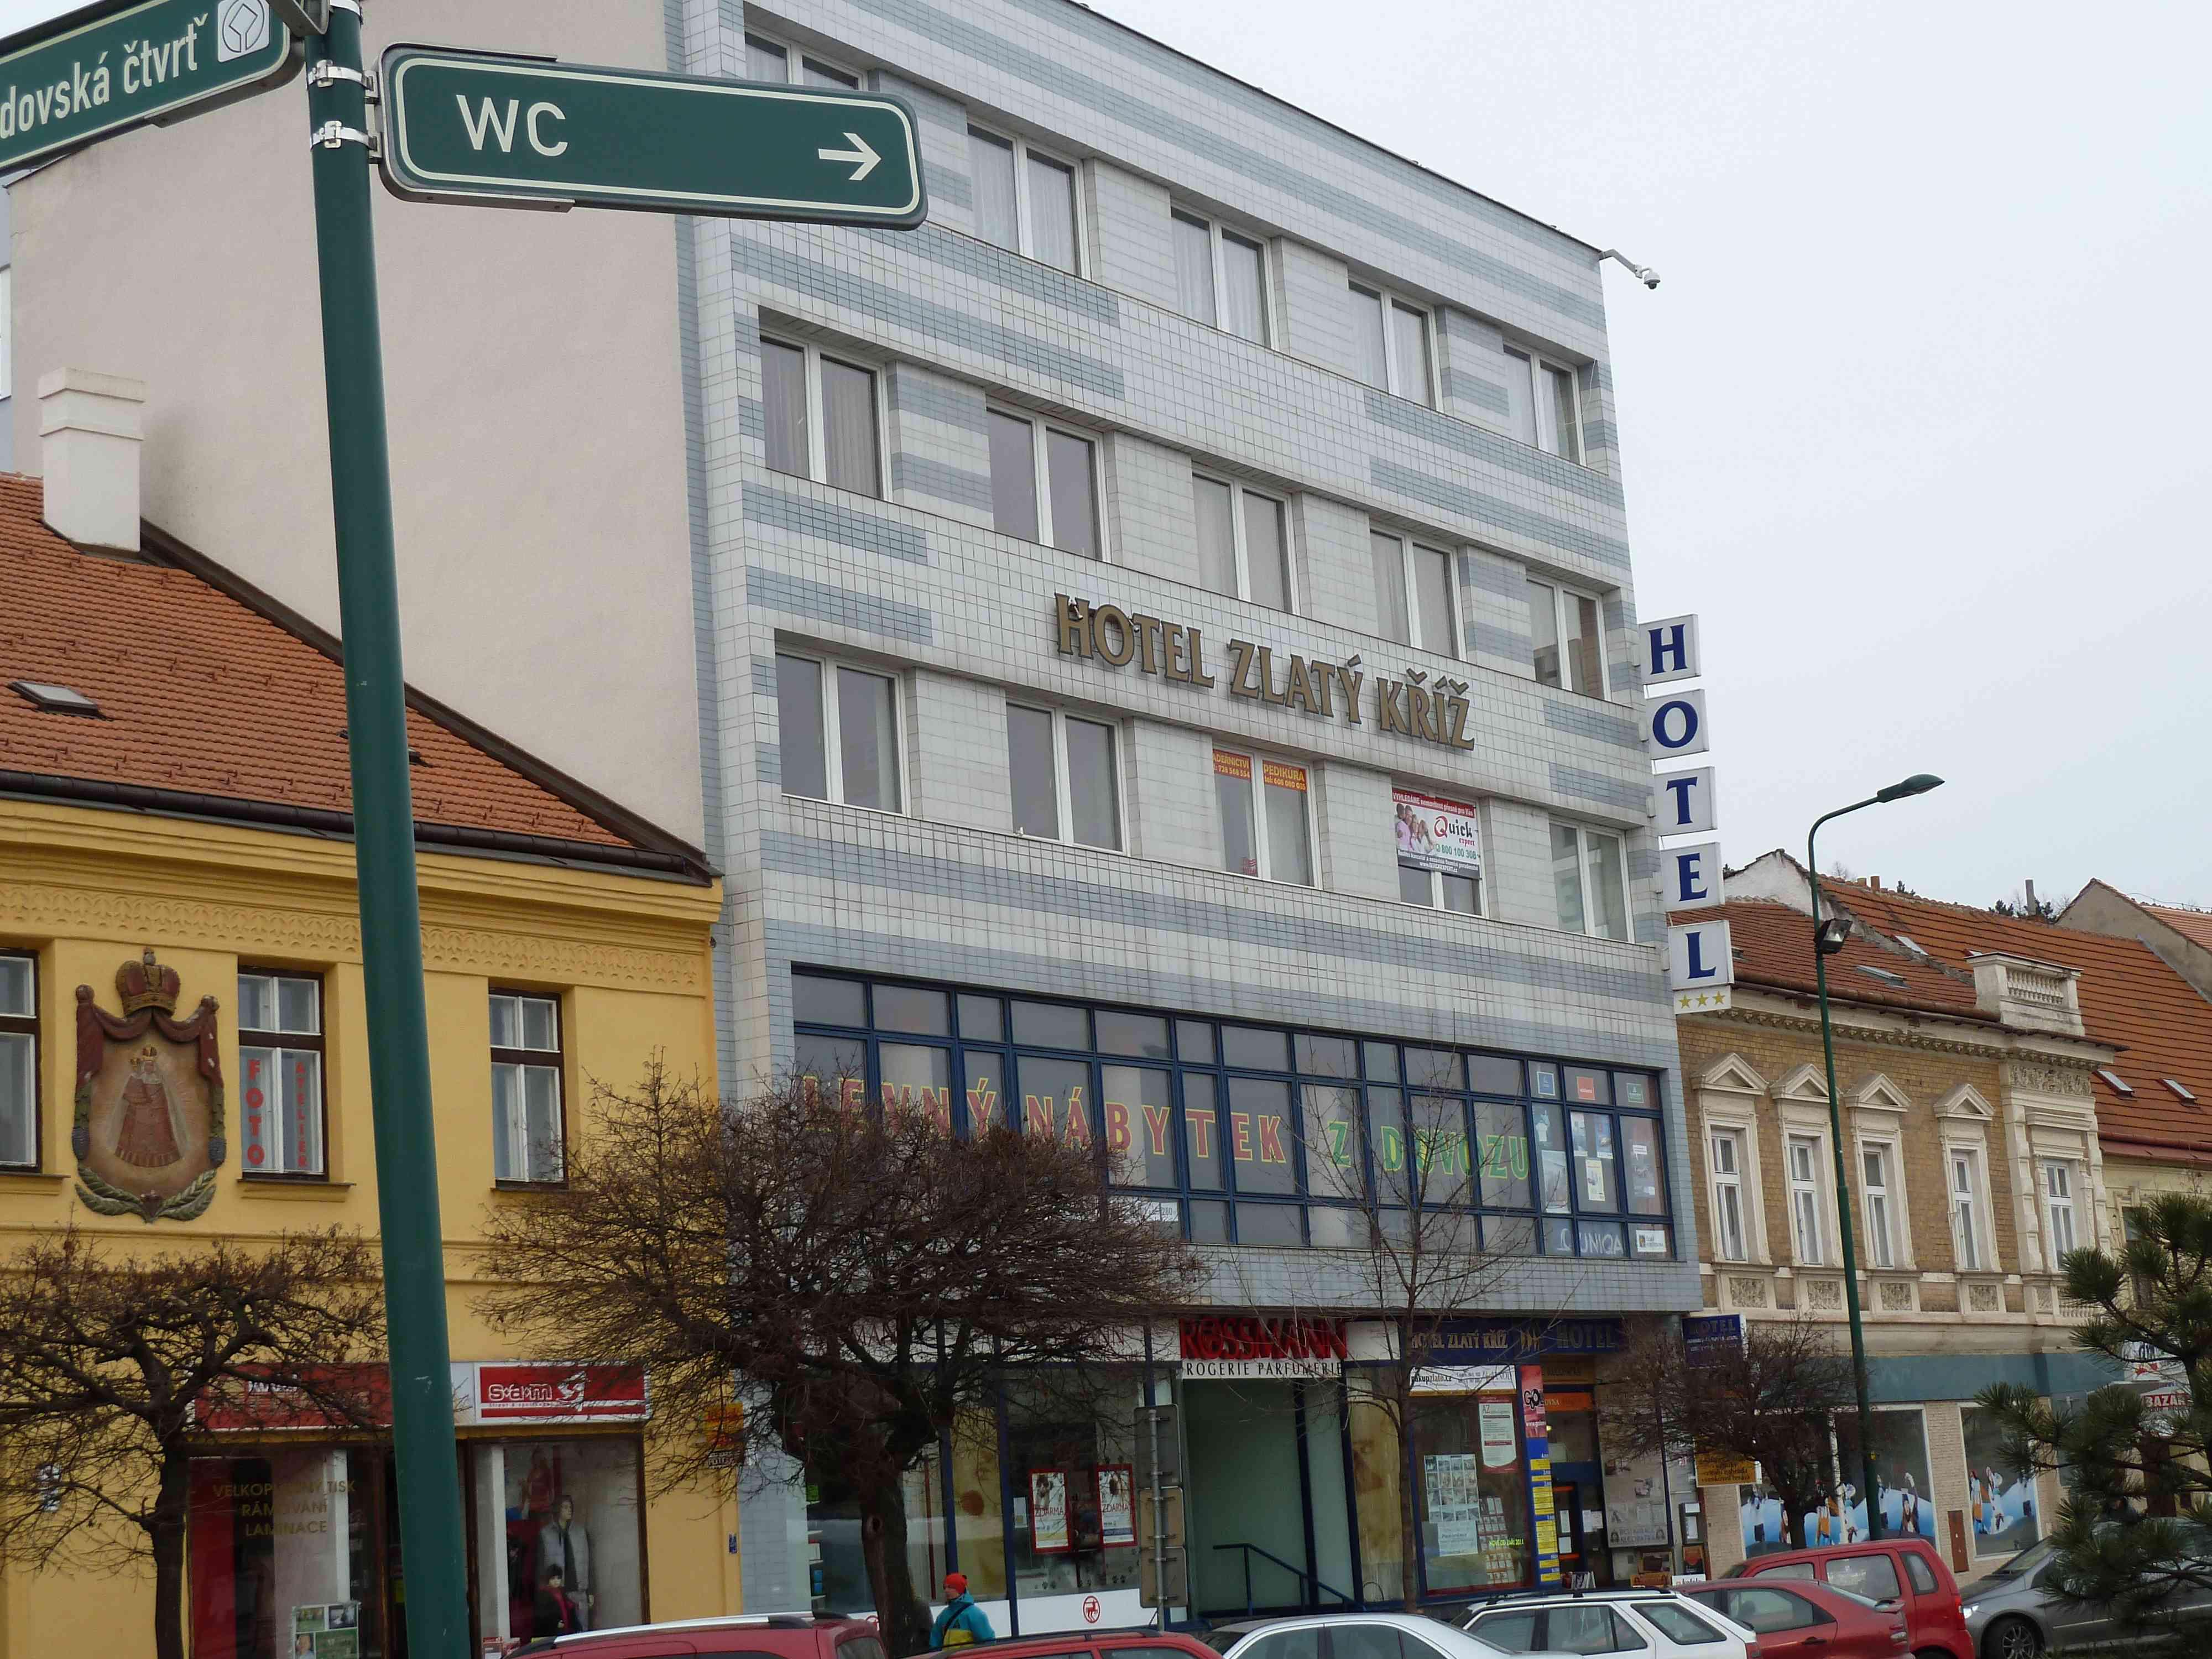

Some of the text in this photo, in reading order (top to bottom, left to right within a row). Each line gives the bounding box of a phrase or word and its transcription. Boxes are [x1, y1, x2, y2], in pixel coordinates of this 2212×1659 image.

[0, 13, 208, 139] dovská čtvrť
[456, 95, 568, 156] WC
[1055, 593, 1475, 751] HOTEL ZLATÝ KŘÍŽ
[1264, 764, 1305, 782] PEDIKÚRA
[1648, 624, 1716, 979] HOTEL
[1434, 815, 1473, 838] Quick
[1442, 844, 1452, 855] 800
[1454, 847, 1464, 857] 100
[1459, 837, 1475, 848] expert
[246, 1059, 265, 1166] FOTO
[296, 1061, 307, 1168] ATELIER
[1025, 1086, 1287, 1164] NÁBYTEK
[1328, 1120, 1352, 1168] Z
[1579, 1232, 1624, 1255] UNIQA
[1179, 1317, 1348, 1359] ROSSMANN
[2145, 1395, 2185, 1407] BAZAR
[327, 1479, 356, 1493] TISK
[1035, 1507, 1064, 1517] ZDARMA
[1102, 1503, 1129, 1514] ZDARMA
[246, 1520, 328, 1536] LAMINACE
